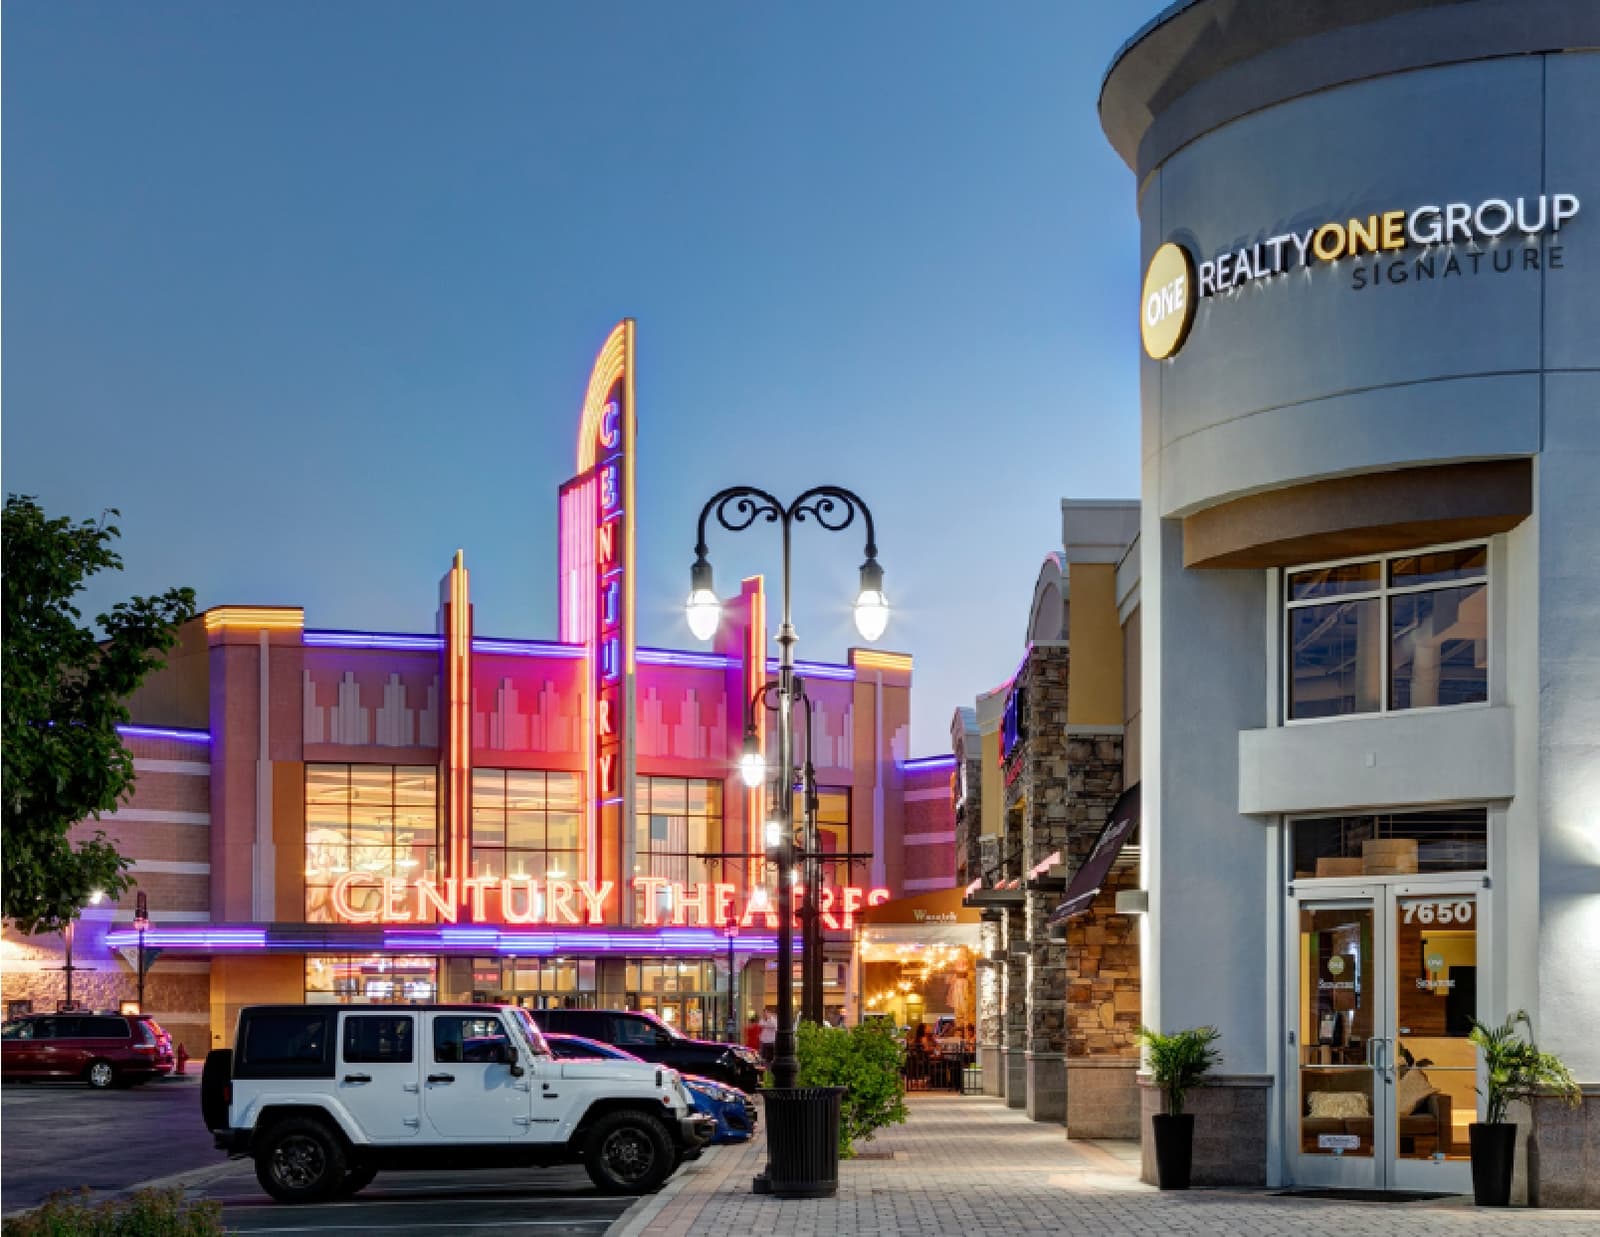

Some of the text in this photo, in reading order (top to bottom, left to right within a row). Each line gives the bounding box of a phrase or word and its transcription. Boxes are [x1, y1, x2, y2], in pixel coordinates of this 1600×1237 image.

[1199, 193, 1580, 298] REALTYONEGROUP
[1351, 246, 1564, 291] SIGNATURE
[1146, 275, 1185, 326] ONE
[599, 401, 621, 793] CENTURY
[331, 871, 614, 923] CENTURY
[1401, 902, 1472, 924] 7650
